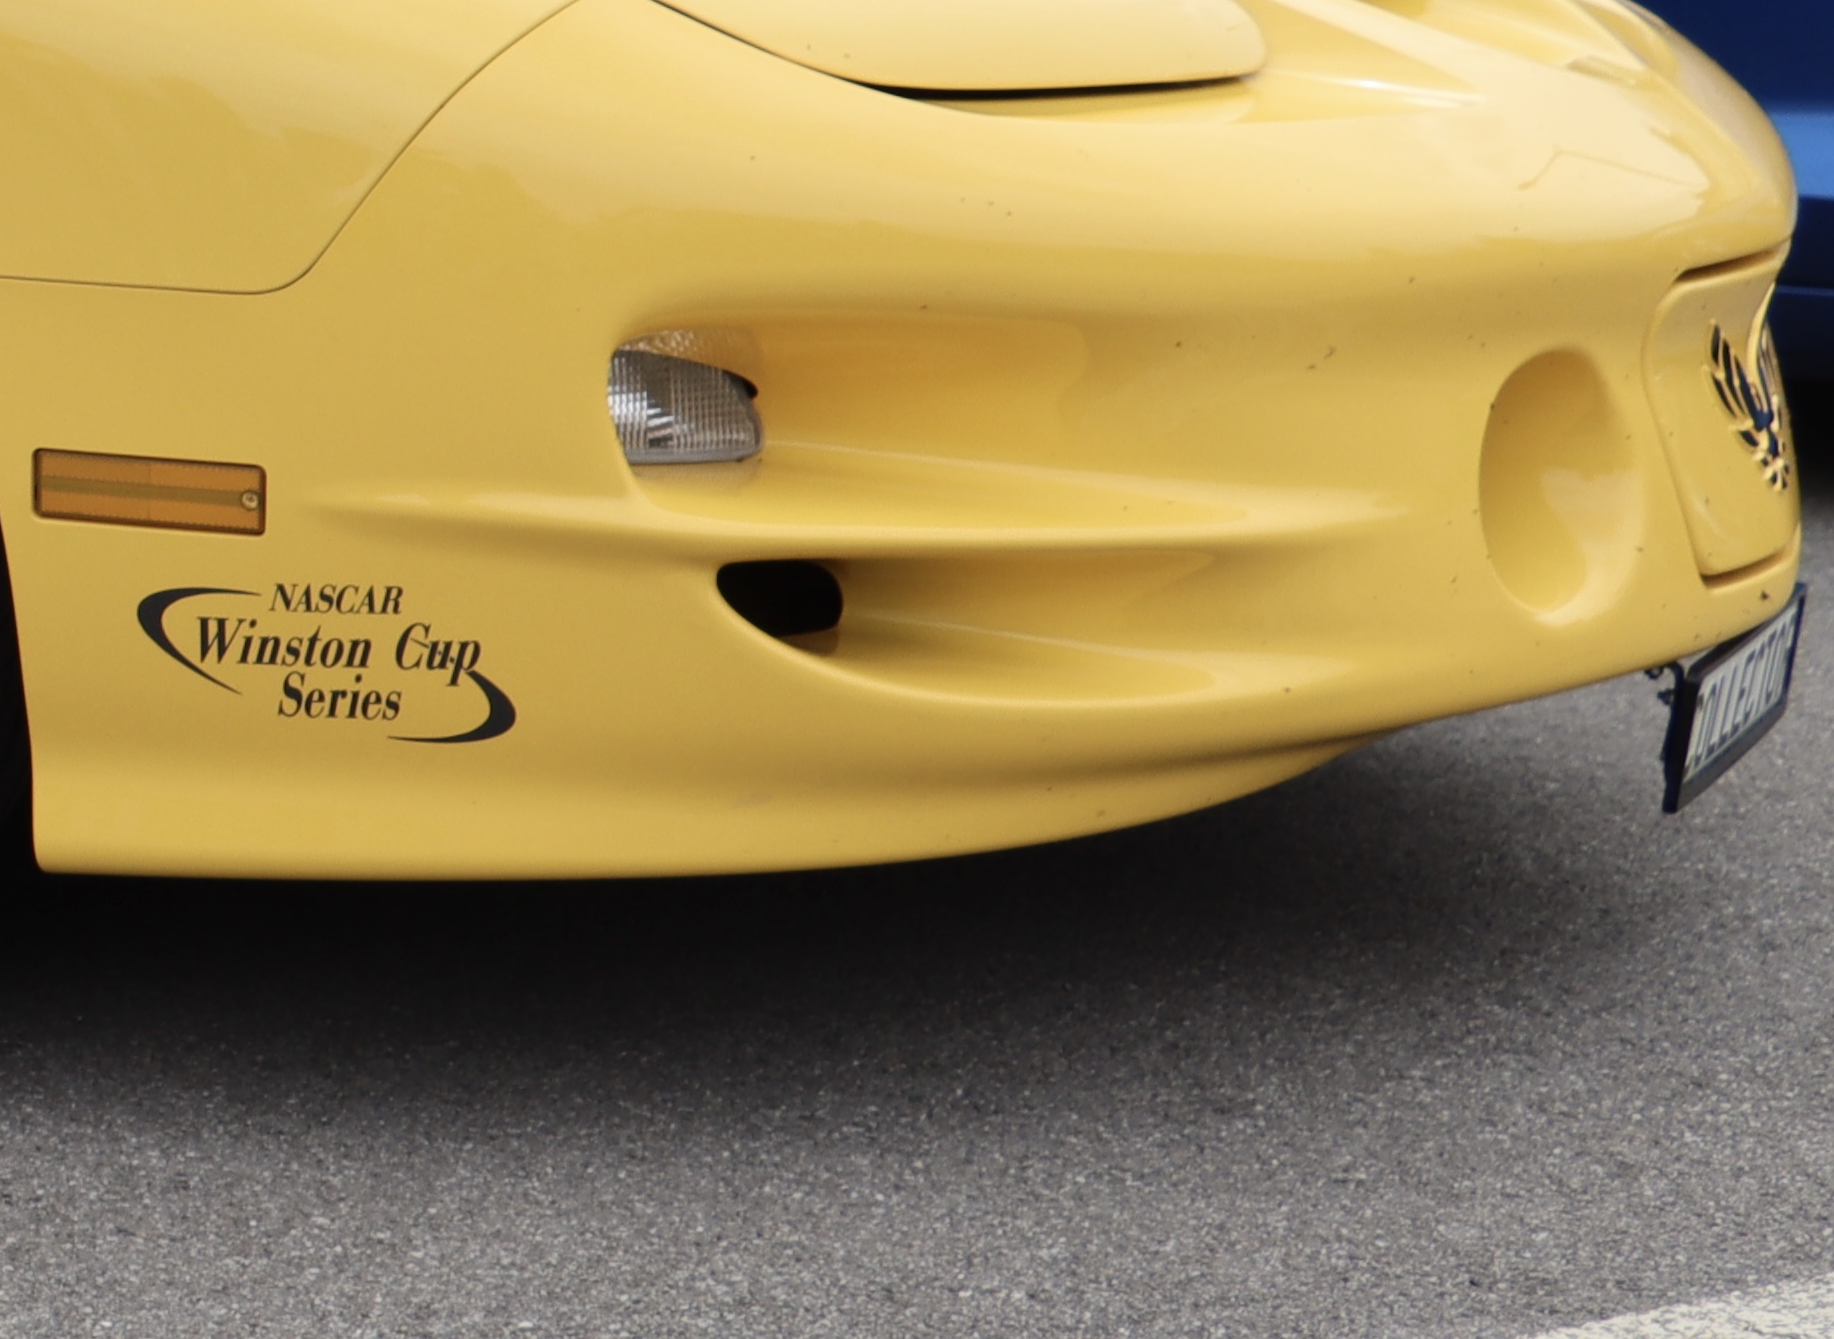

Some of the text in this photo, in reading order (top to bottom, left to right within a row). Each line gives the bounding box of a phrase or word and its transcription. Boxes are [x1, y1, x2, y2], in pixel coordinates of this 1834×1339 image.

[268, 582, 404, 617] NASCAR
[195, 615, 482, 687] Winston Cup
[277, 673, 403, 722] Series
